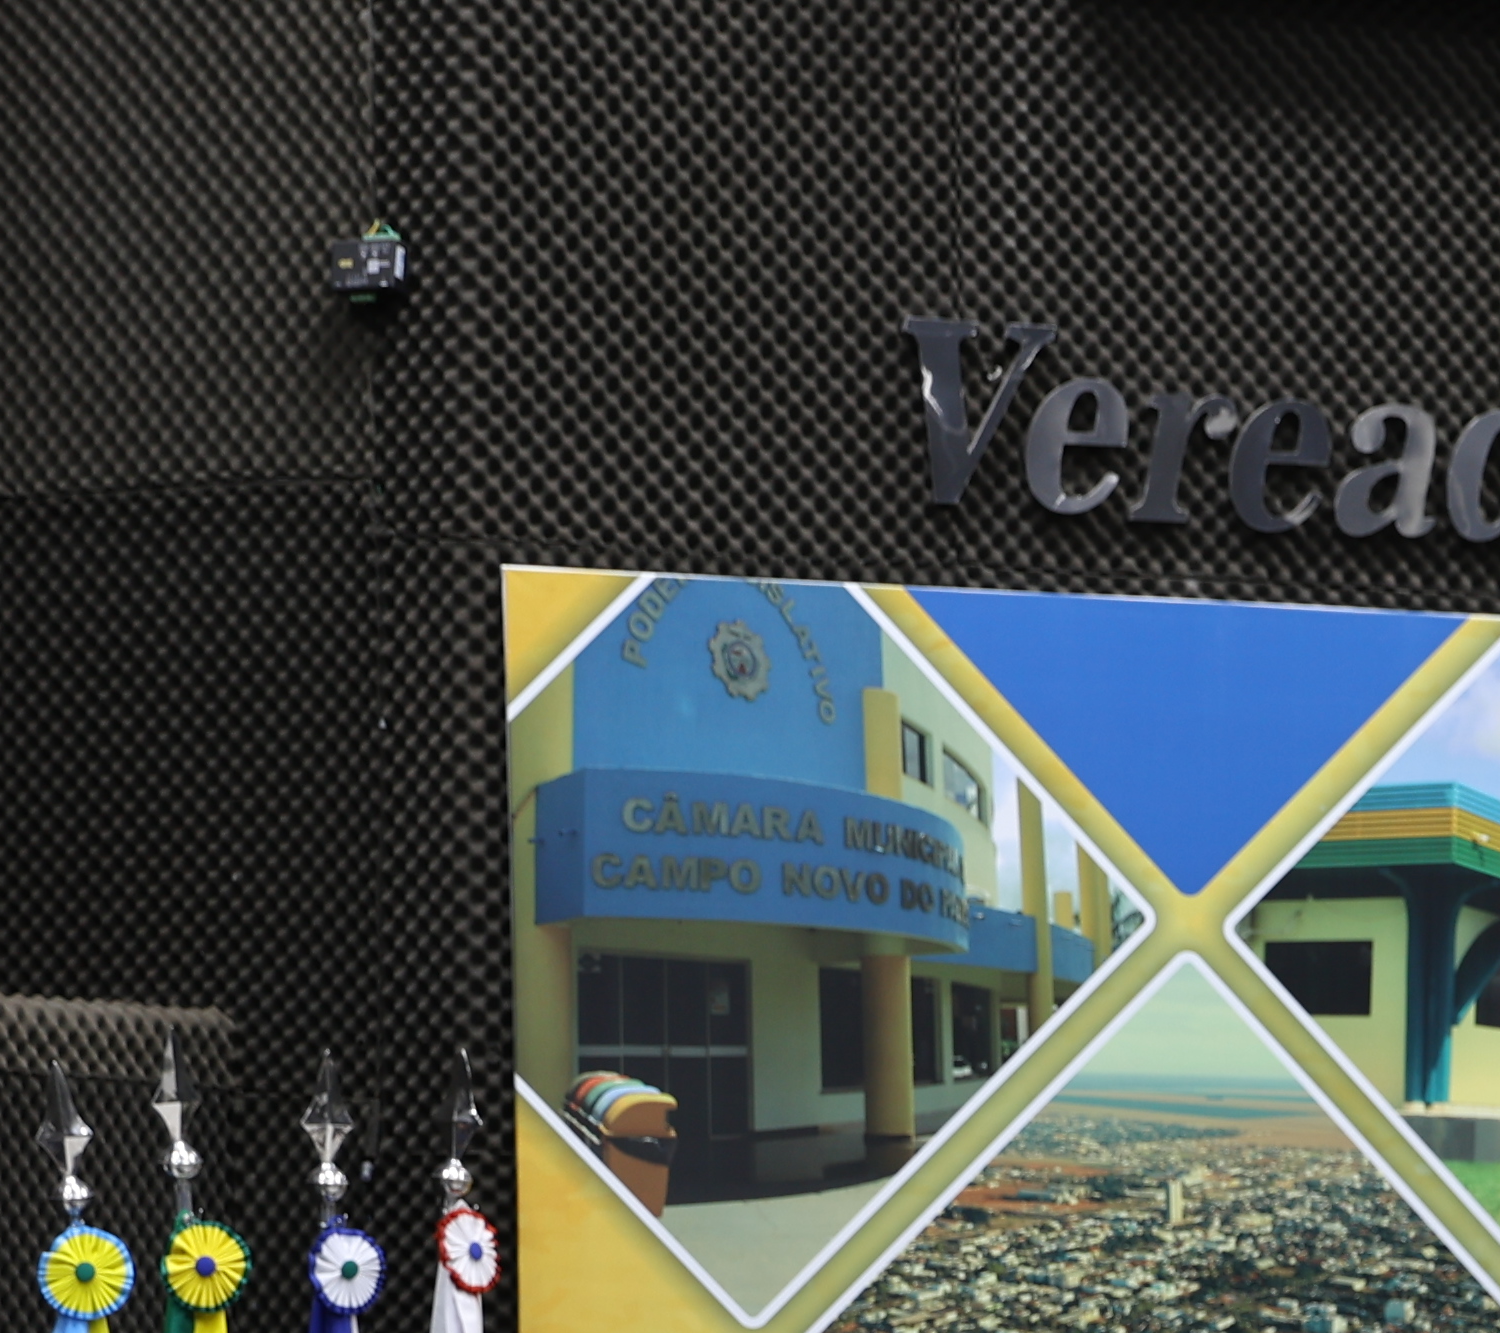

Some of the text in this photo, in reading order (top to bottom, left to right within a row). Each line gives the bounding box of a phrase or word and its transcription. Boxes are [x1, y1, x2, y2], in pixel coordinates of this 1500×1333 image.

[621, 792, 825, 846] CÂMARA
[591, 853, 762, 895] CAMPO
[781, 862, 890, 907] NOVO
[900, 877, 935, 913] DO
